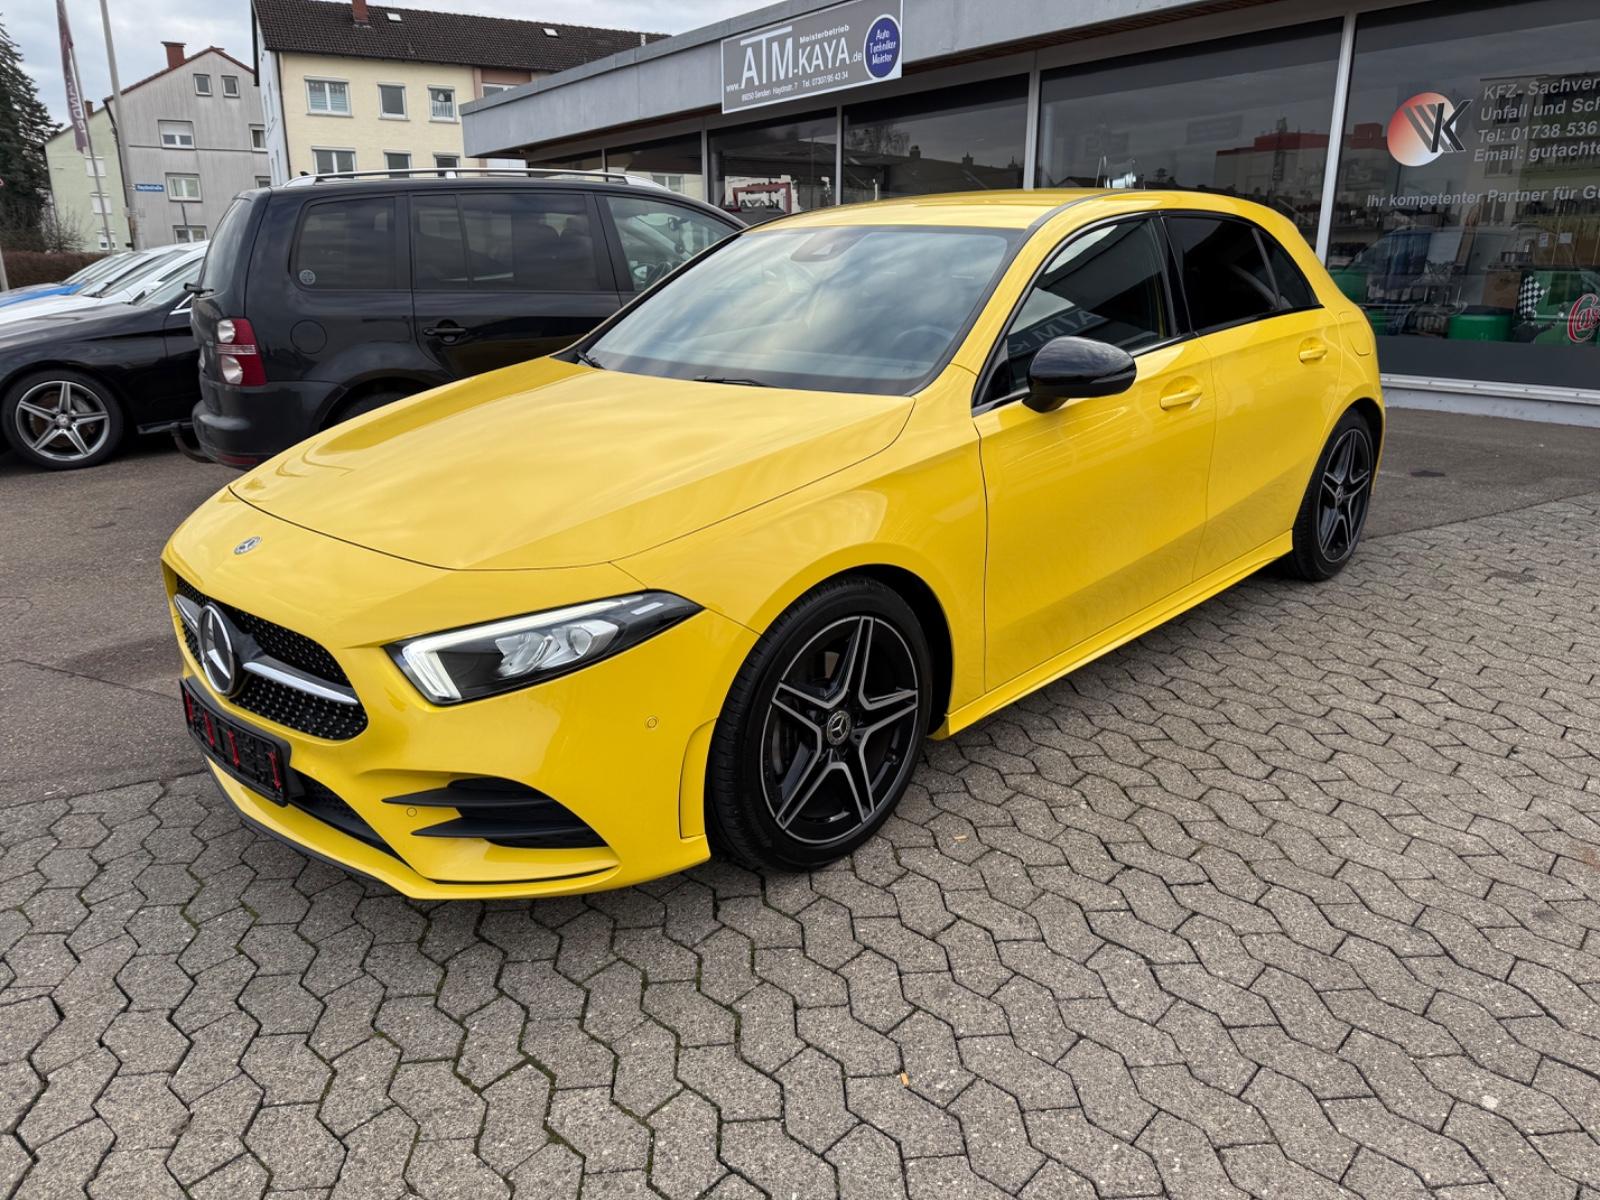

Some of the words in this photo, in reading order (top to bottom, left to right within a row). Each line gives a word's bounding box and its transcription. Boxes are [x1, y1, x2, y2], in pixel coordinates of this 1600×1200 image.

[800, 24, 849, 44] Meisterbetrieb
[1483, 83, 1523, 100] KFZ-
[1528, 78, 1600, 96] Sachver
[1480, 103, 1528, 121] Unfall
[1533, 100, 1567, 117] und
[1478, 128, 1505, 143] Tel:
[1511, 123, 1560, 140] 01738
[1474, 145, 1524, 162] Email:
[1367, 194, 1385, 208] Ihr
[1389, 191, 1481, 210] kompetenter
[1487, 188, 1548, 203] Partner
[1553, 185, 1577, 200] für
[1583, 185, 1600, 199] G
